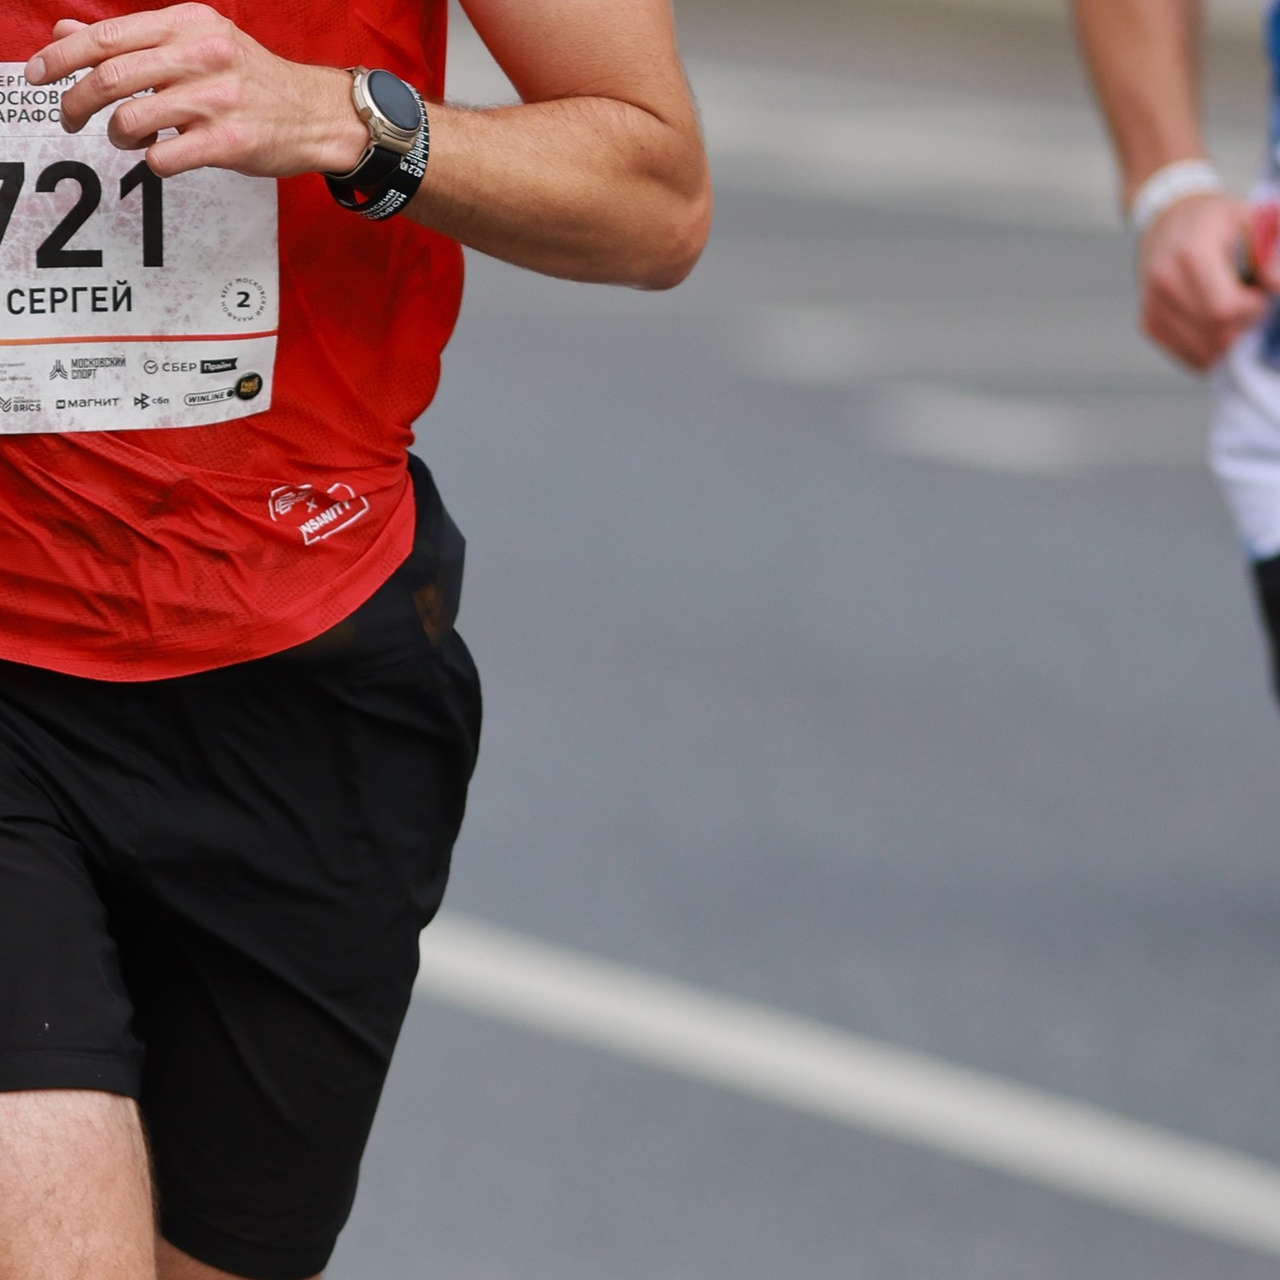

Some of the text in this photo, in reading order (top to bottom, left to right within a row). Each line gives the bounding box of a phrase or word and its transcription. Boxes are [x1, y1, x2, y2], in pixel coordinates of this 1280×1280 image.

[7, 280, 133, 316] СЕРГЕЙ
[236, 291, 251, 308] 2
[161, 362, 198, 373] СБЕР
[188, 391, 225, 404] WINLINE
